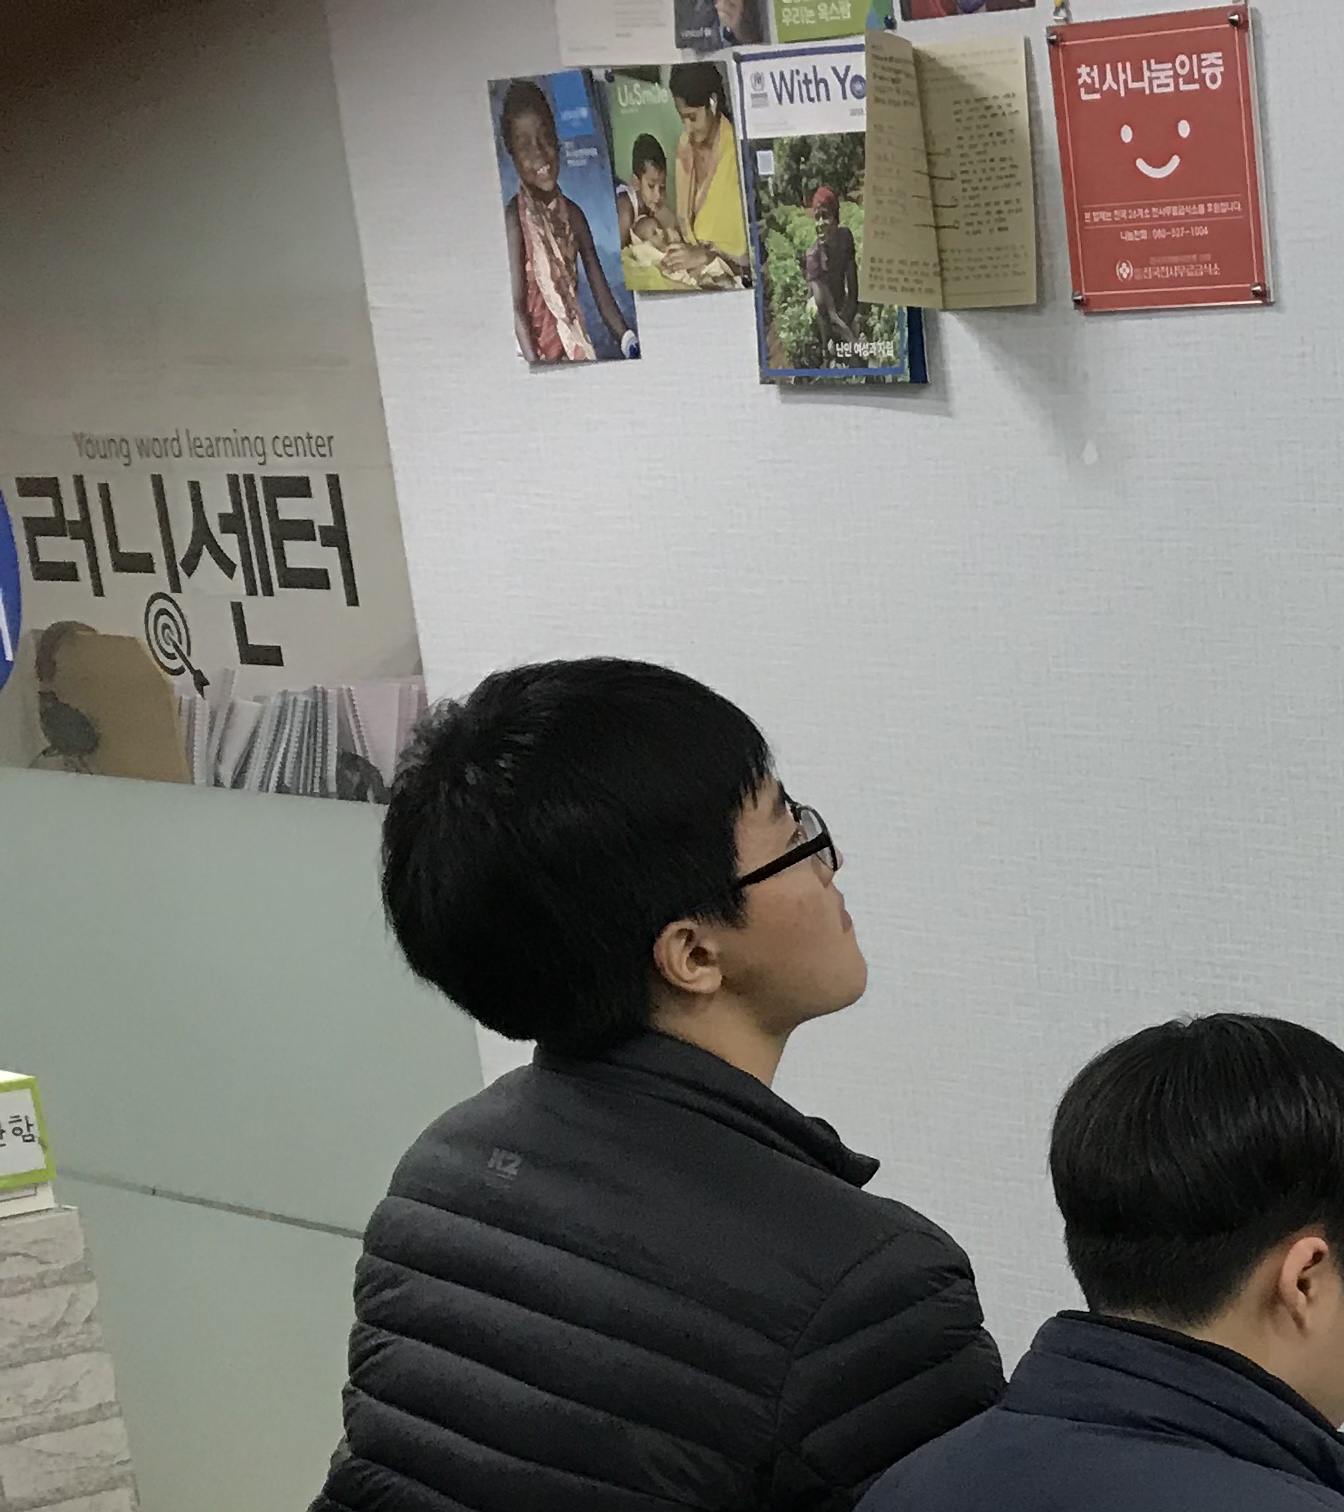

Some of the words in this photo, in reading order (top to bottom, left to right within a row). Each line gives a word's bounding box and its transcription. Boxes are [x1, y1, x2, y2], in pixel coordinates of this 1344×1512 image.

[782, 7, 816, 26] 우리는
[769, 65, 831, 106] With
[831, 64, 866, 100] Yo
[1077, 52, 1224, 101] 천사나눔인증
[72, 431, 132, 466] Young
[135, 428, 183, 459] word
[185, 428, 267, 466] learning
[271, 431, 335, 459] center
[15, 474, 360, 698] 러닝센터
